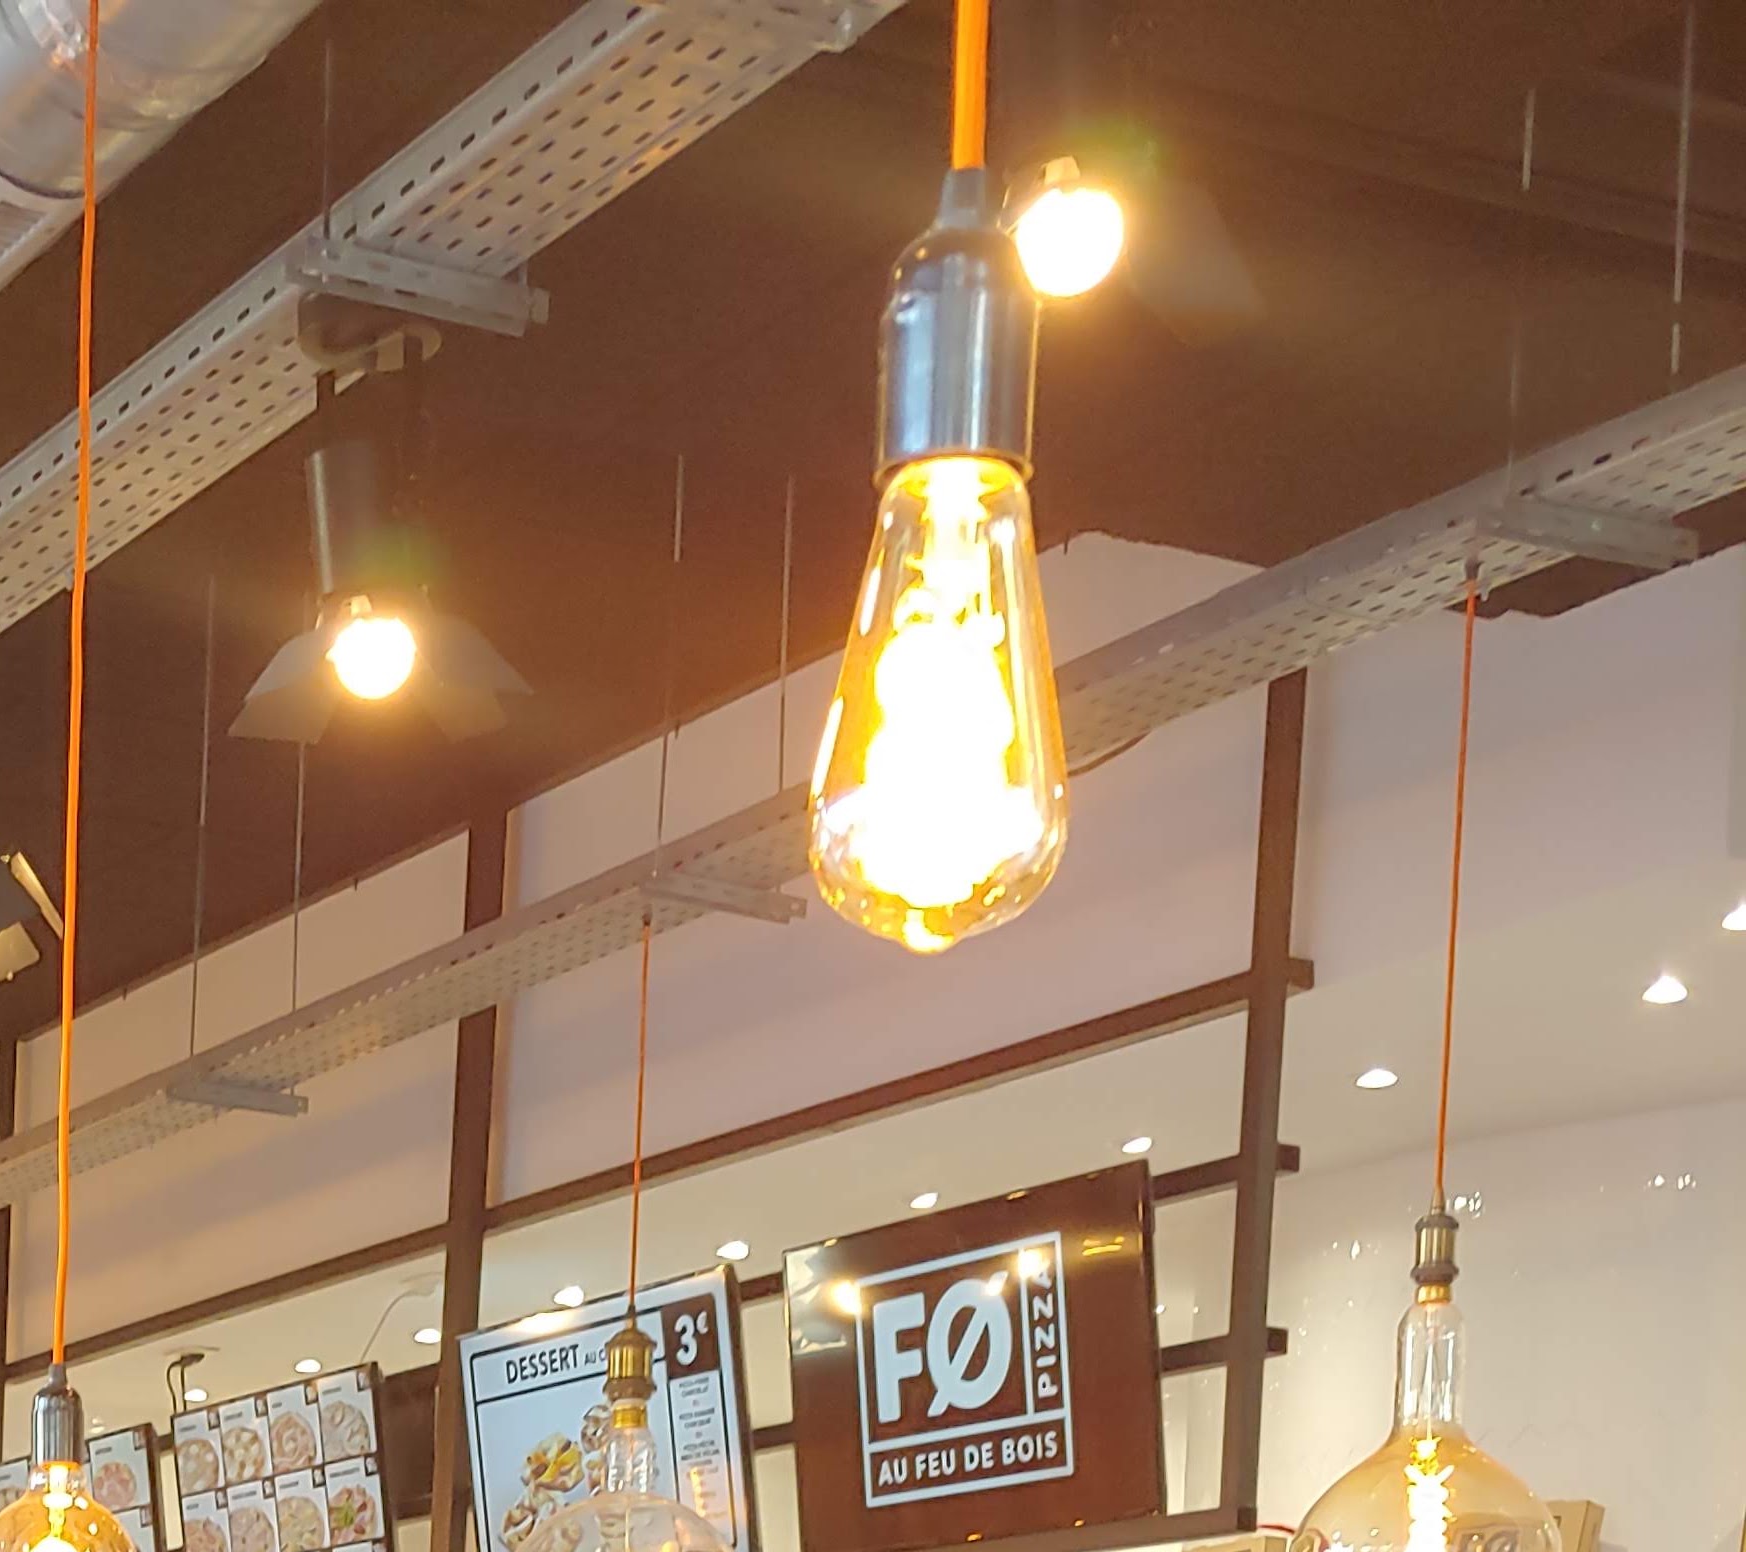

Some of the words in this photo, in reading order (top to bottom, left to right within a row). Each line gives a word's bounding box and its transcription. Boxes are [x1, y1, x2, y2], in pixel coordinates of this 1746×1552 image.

[505, 1344, 579, 1384] DESSERT
[873, 1270, 1013, 1423] FØ
[1033, 1266, 1058, 1399] PIZZA
[878, 1457, 907, 1487] AU
[915, 1448, 956, 1480] FEU
[963, 1441, 994, 1472] DE
[1002, 1430, 1057, 1466] BOIS
